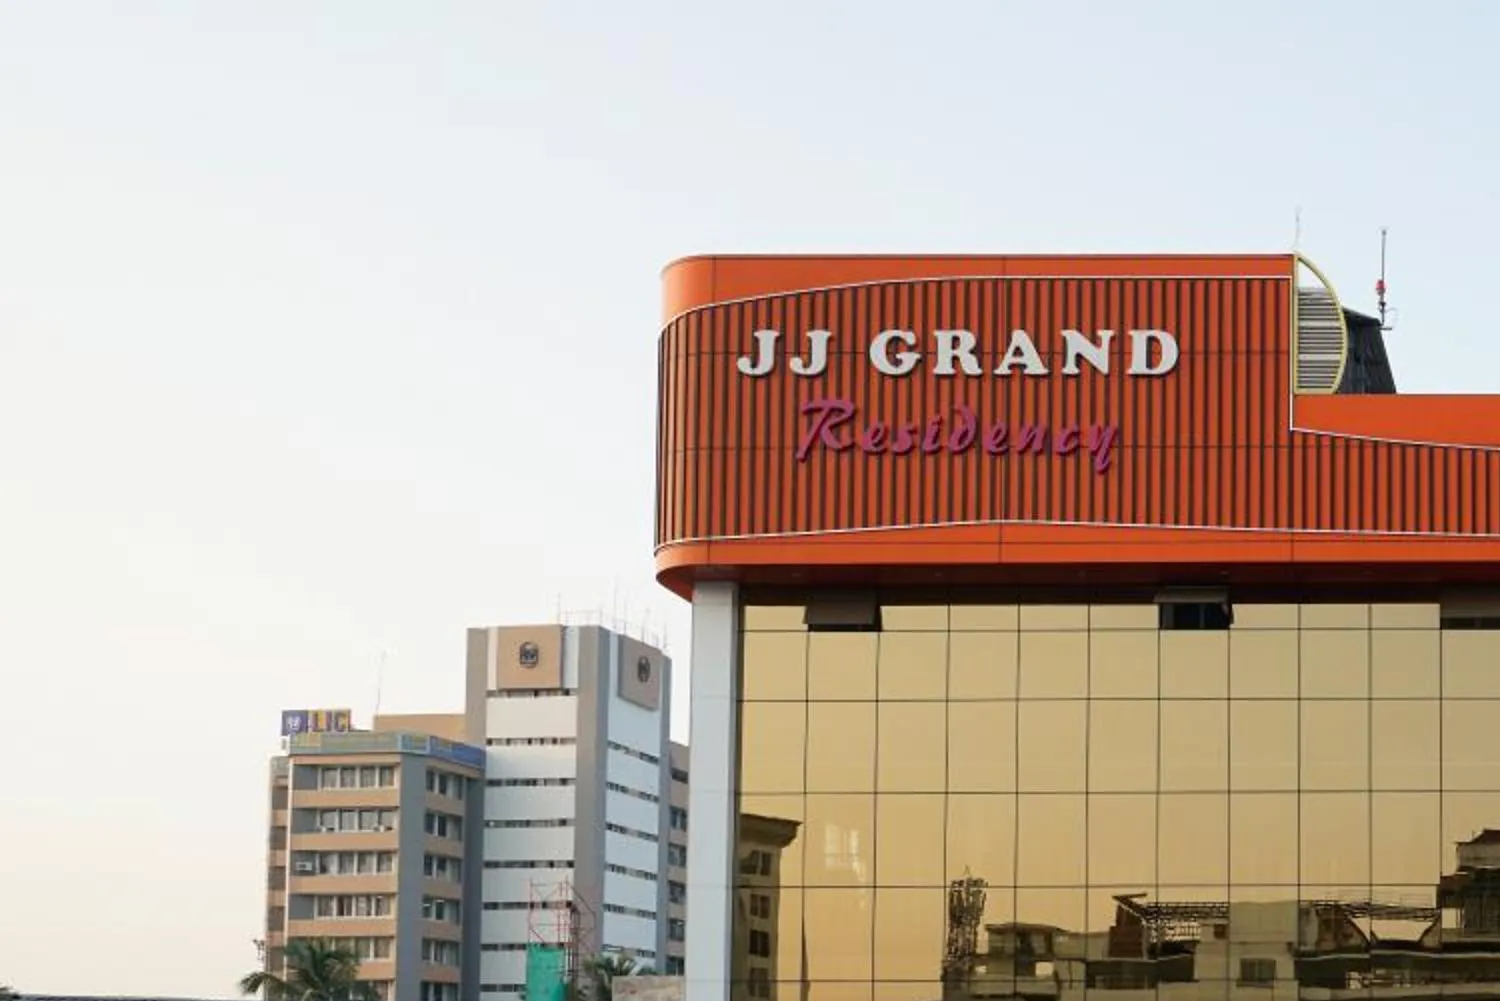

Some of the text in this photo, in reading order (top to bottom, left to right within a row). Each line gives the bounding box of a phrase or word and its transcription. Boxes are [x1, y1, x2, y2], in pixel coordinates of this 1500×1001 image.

[737, 329, 1180, 376] JJ GRAND
[797, 399, 1119, 472] Residency
